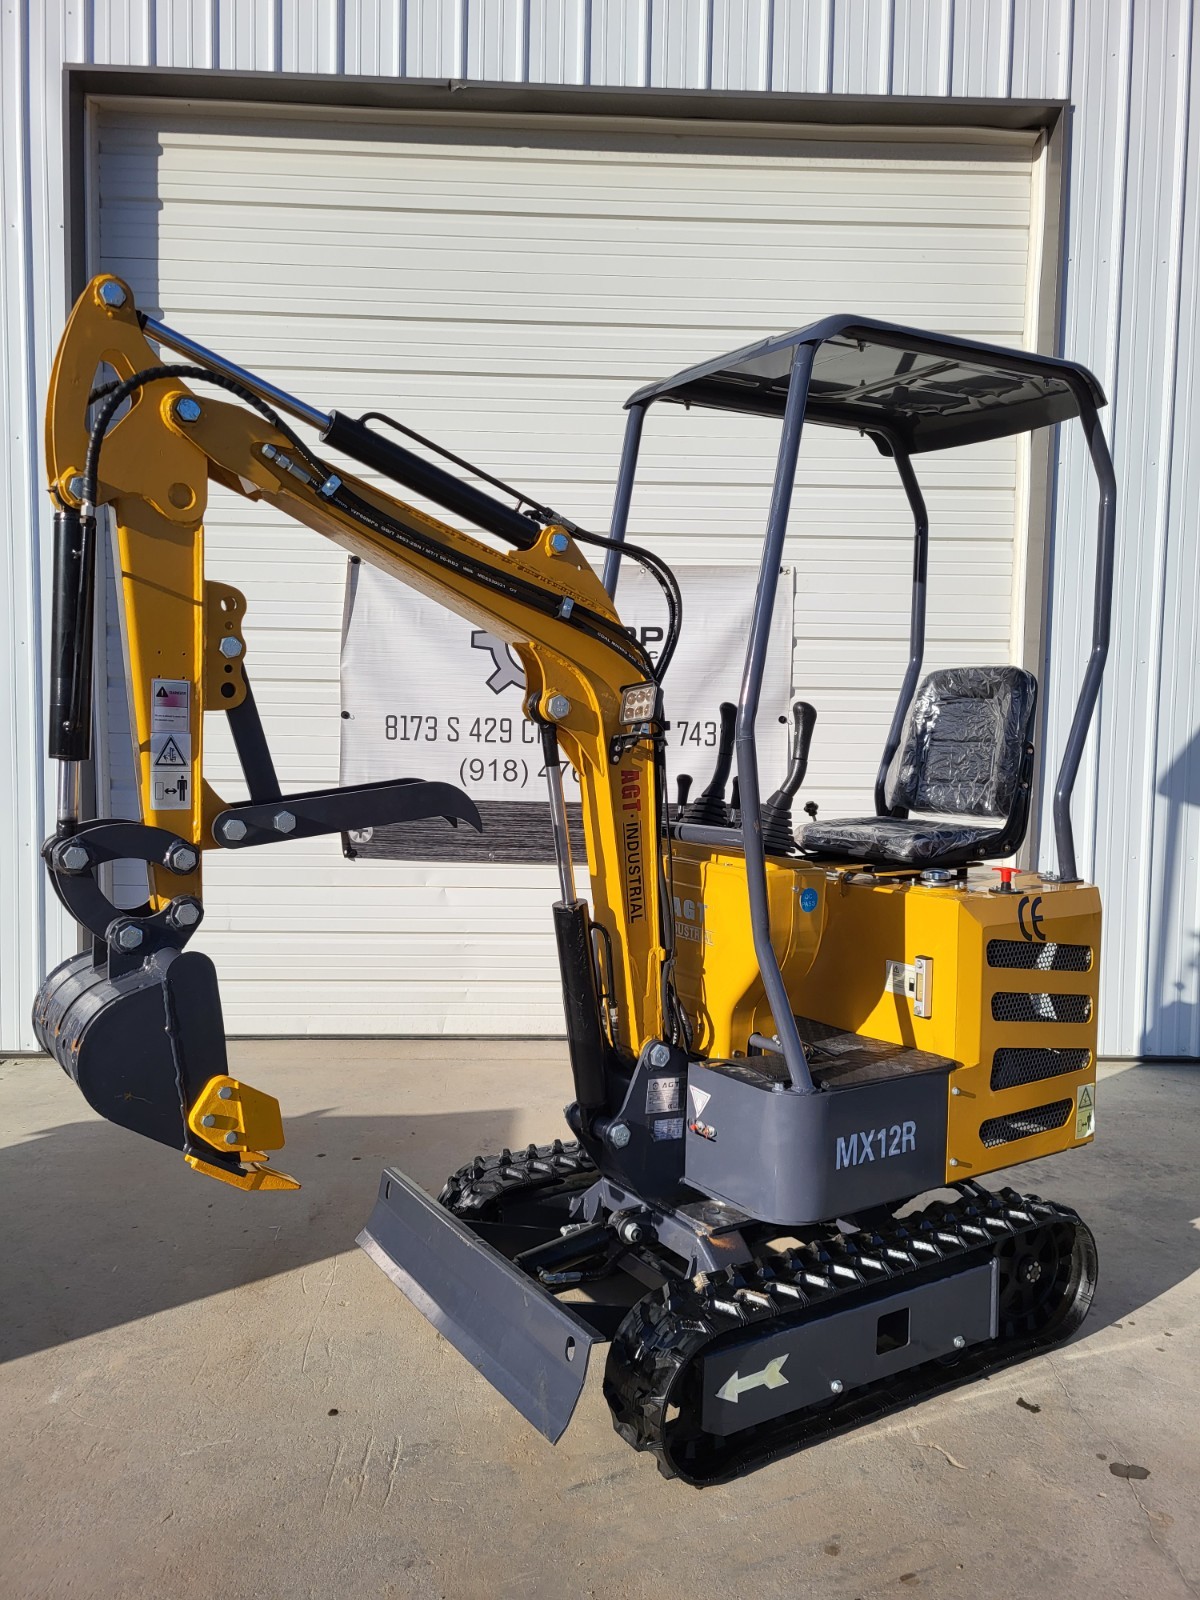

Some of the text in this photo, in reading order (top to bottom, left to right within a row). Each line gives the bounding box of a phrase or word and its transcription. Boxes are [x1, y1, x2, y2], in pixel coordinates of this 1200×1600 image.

[385, 714, 438, 742] 8173
[447, 716, 460, 743] S
[469, 717, 512, 744] 429
[521, 718, 542, 744] C
[459, 757, 529, 789] (918)
[620, 769, 643, 923] AGT INDUSTRIAL
[1018, 895, 1046, 941] CE
[836, 1120, 917, 1170] MX12R
